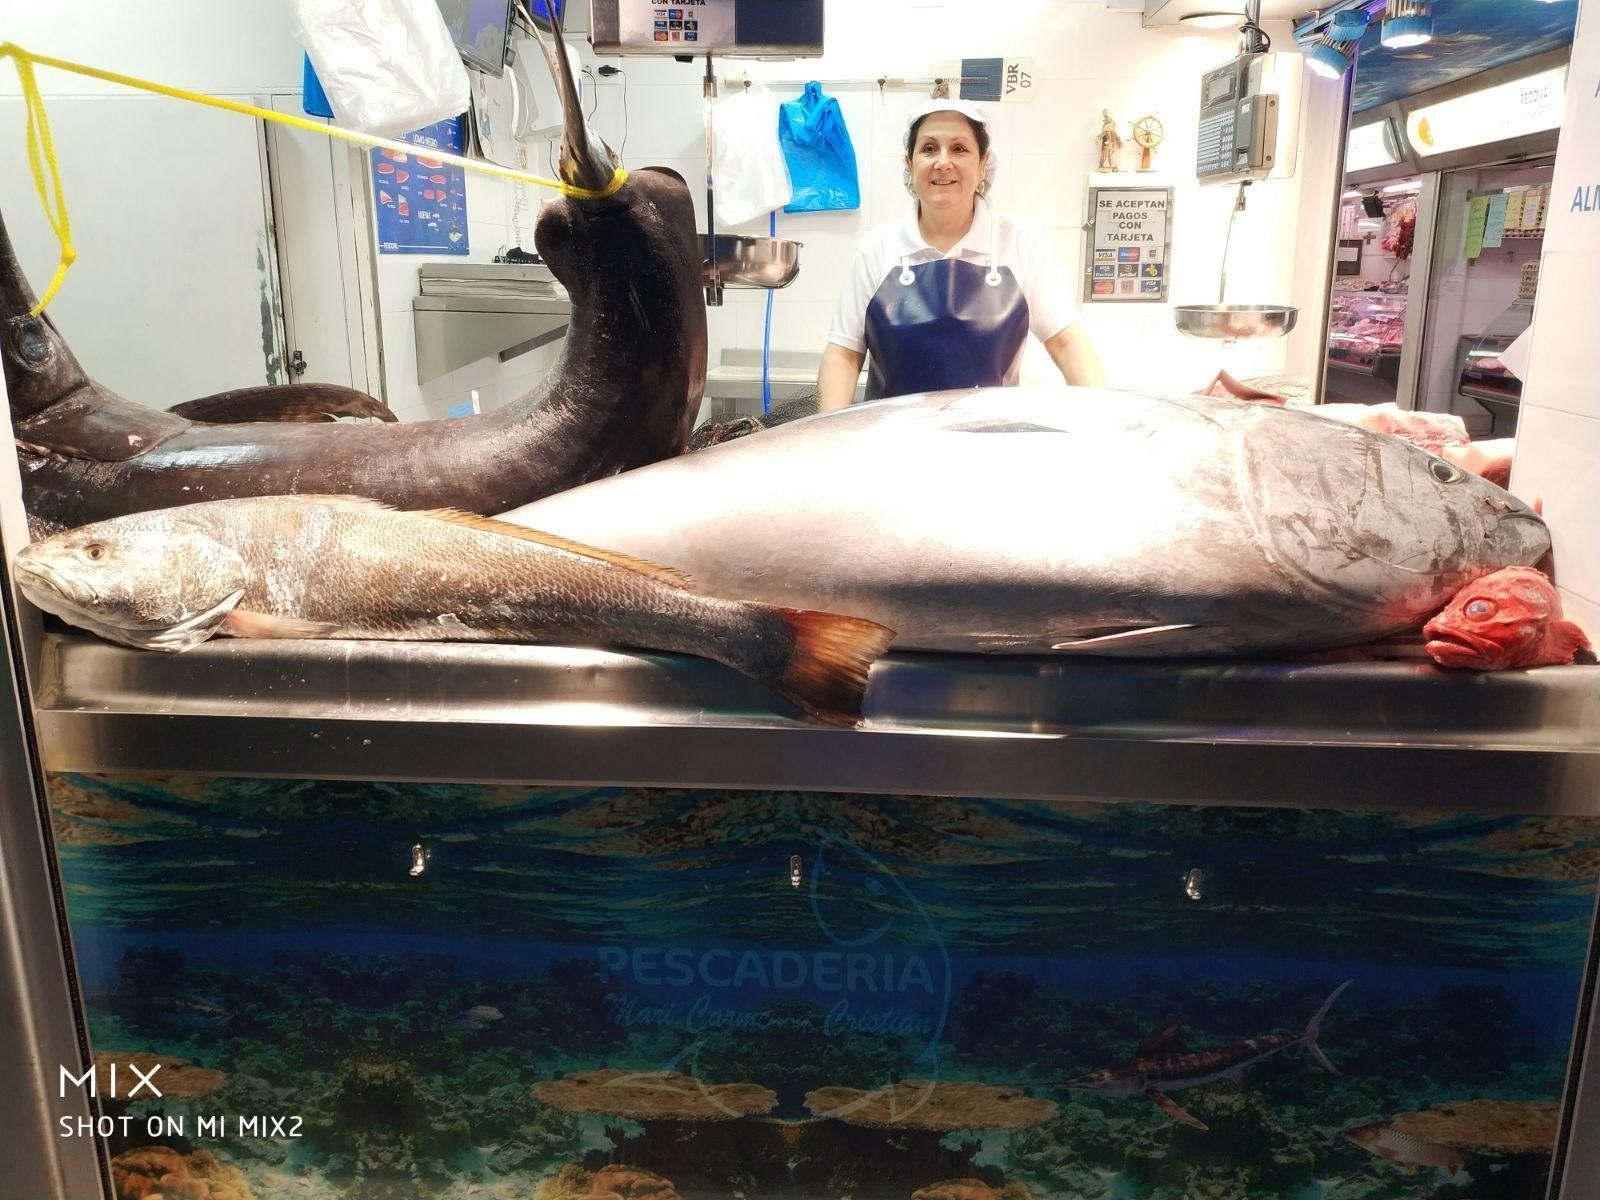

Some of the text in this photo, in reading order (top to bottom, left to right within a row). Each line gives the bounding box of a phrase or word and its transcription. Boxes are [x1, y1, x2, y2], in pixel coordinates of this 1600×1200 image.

[1006, 64, 1019, 96] VBR
[1020, 72, 1032, 88] 07
[1099, 200, 1165, 208] SE ACEPTAN
[1112, 212, 1148, 220] PAGOS
[1118, 221, 1142, 230] CON
[1106, 233, 1154, 241] TARJETA
[597, 946, 935, 993] PESCADERIA
